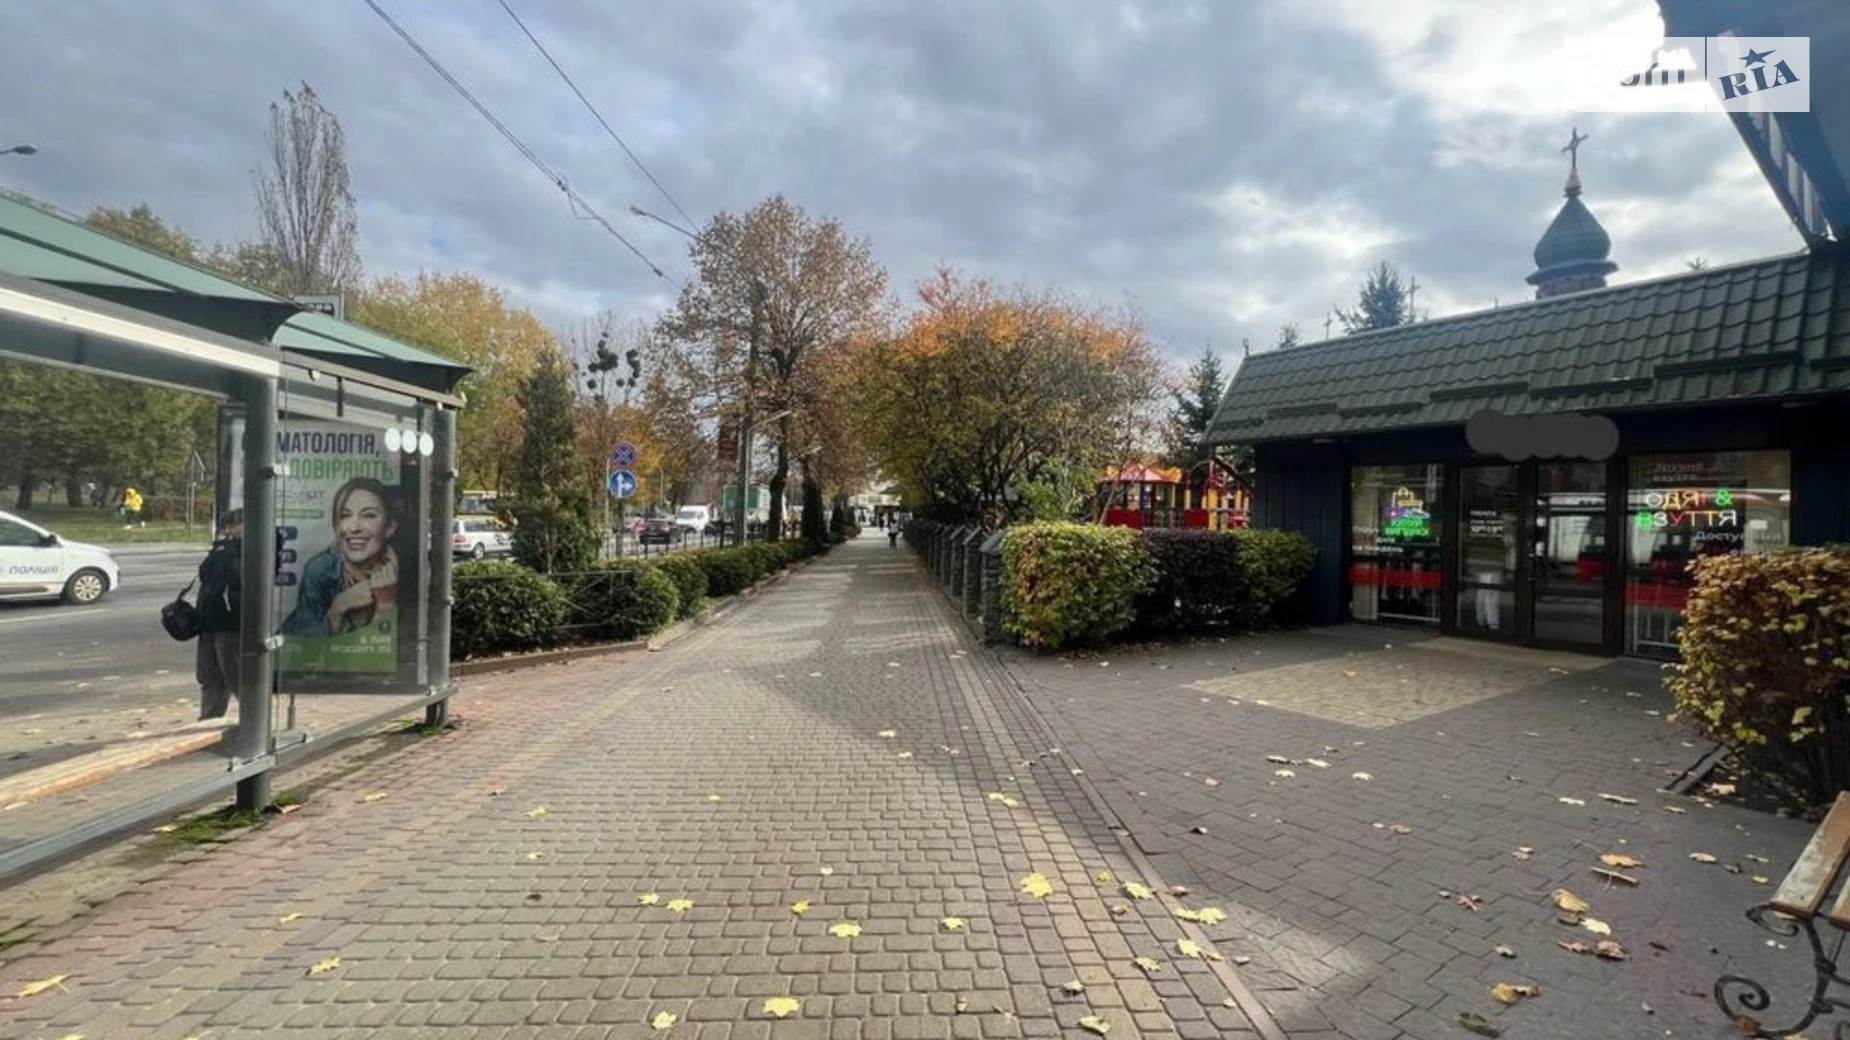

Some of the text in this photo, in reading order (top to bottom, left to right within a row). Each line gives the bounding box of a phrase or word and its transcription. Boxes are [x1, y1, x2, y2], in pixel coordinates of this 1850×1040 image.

[276, 431, 380, 457] МАТОЛОГІЯ,
[1716, 487, 1732, 507] &
[1637, 509, 1737, 529] ВЗУТТЯ
